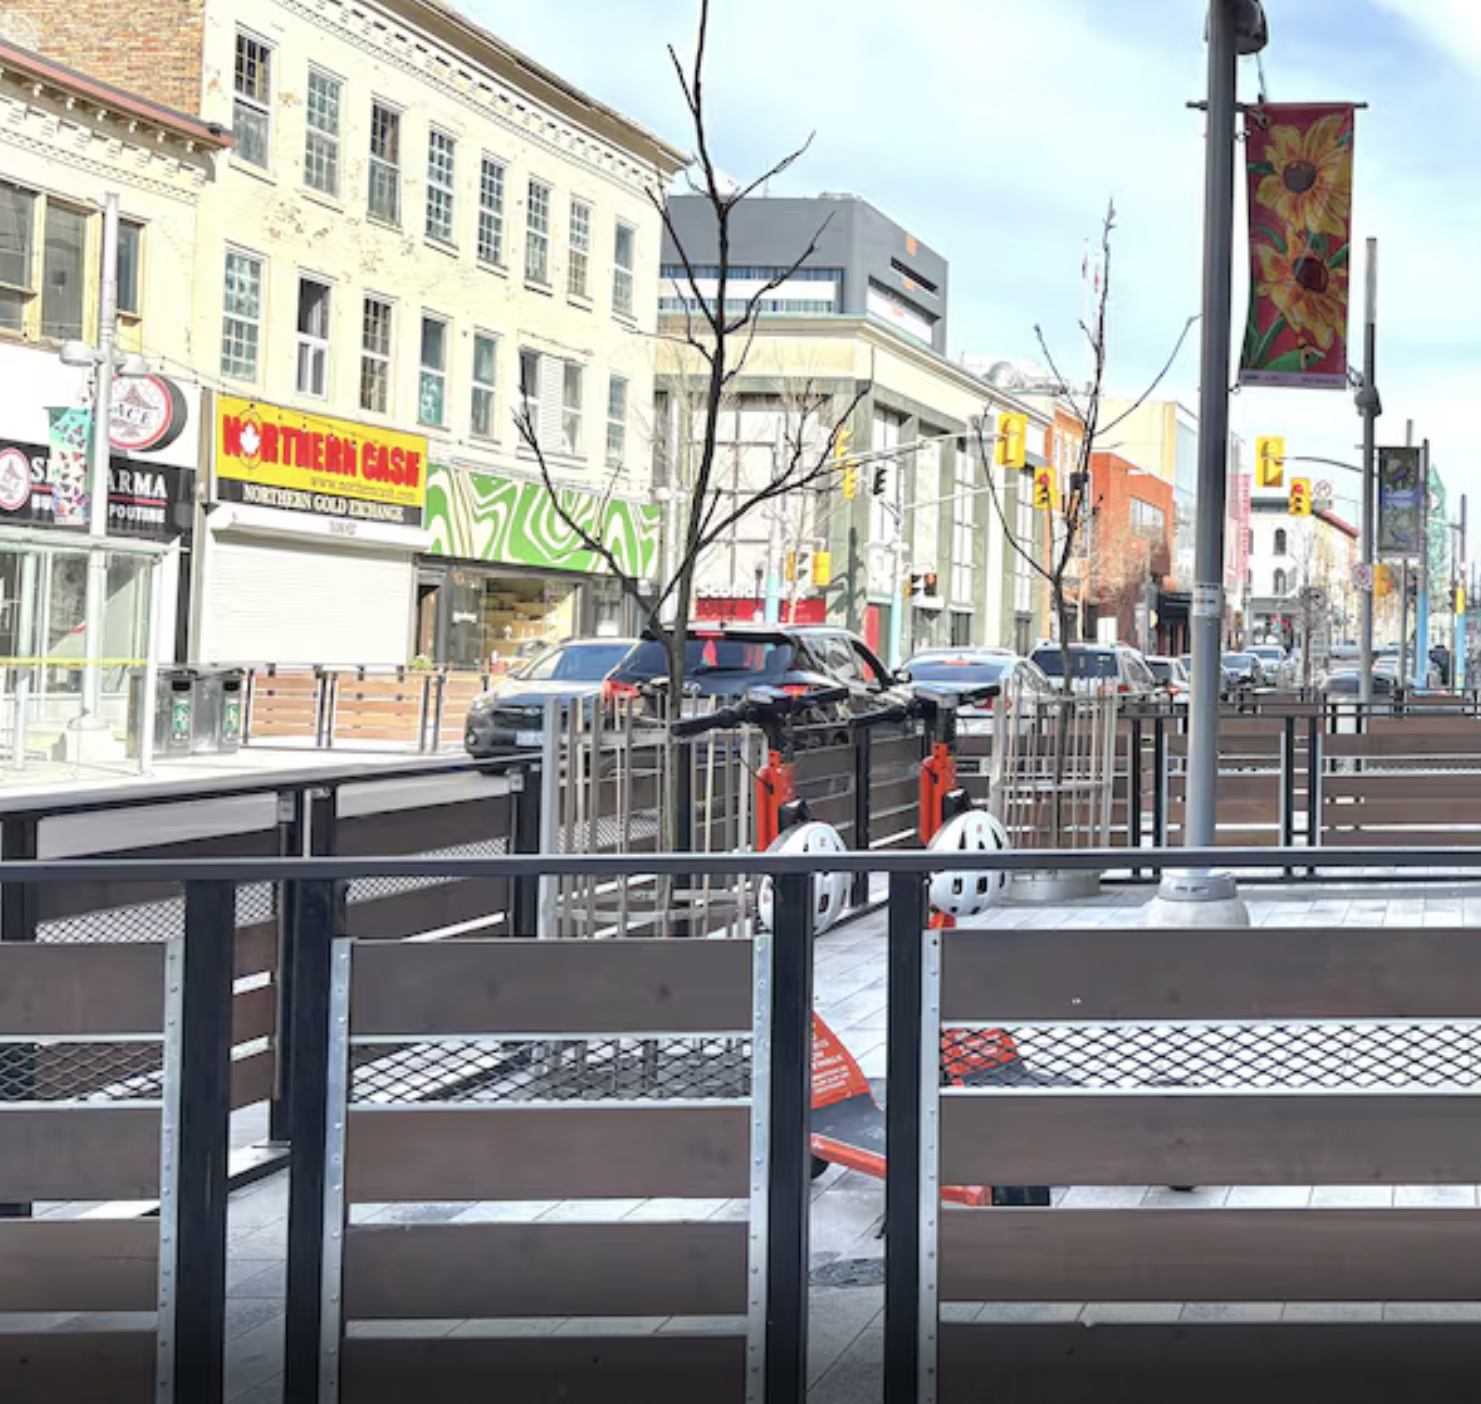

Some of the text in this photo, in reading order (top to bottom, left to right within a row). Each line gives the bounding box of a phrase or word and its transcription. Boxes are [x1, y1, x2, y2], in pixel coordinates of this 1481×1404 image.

[361, 441, 420, 488] CASH
[109, 504, 166, 523] POUTINE
[242, 483, 312, 510] NORTHERN
[313, 495, 347, 516] GOLD
